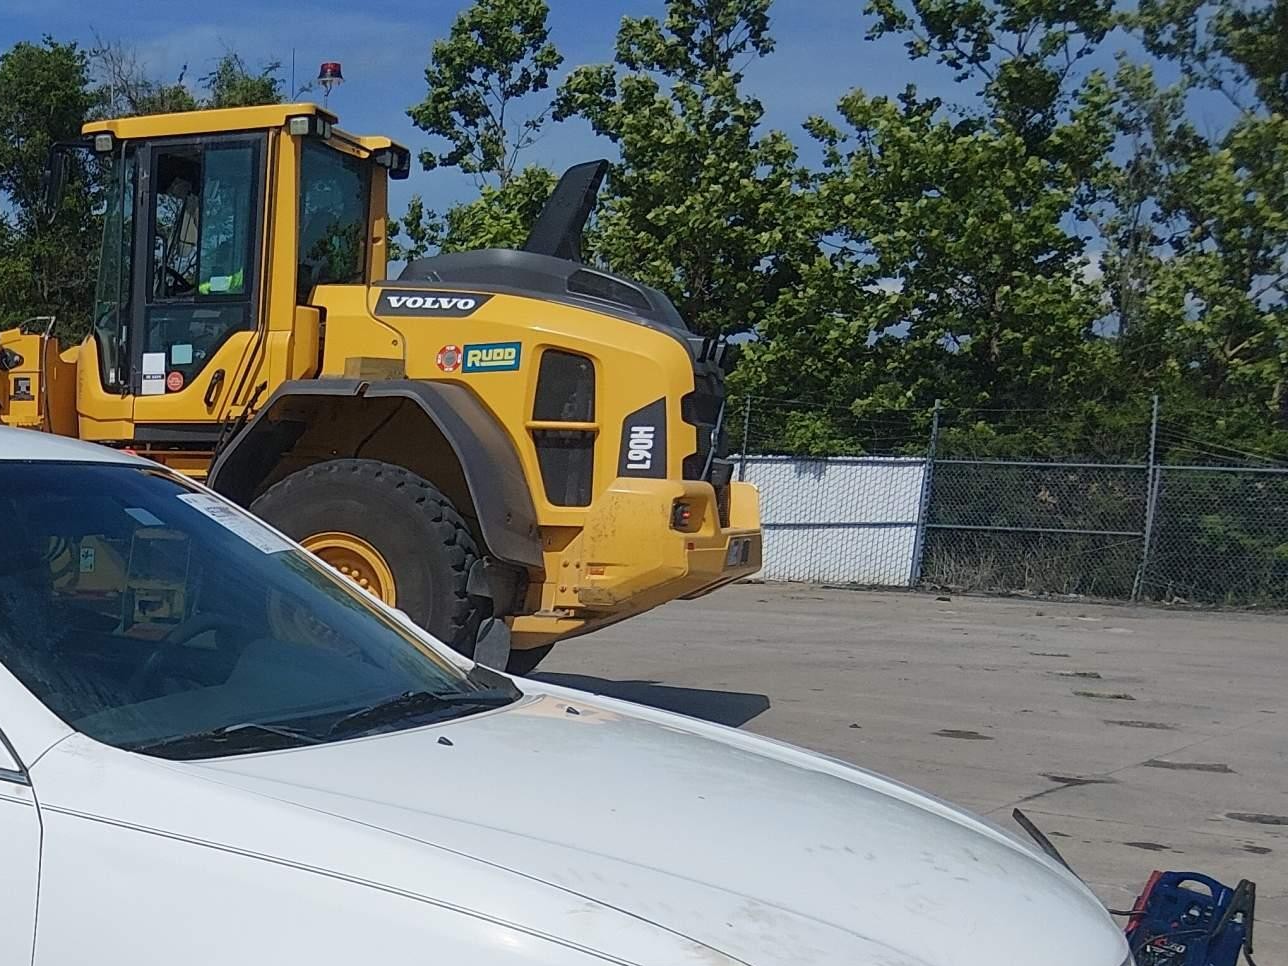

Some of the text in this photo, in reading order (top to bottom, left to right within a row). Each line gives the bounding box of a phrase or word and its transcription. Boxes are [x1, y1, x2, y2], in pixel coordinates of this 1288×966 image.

[387, 294, 476, 310] VOLVO
[467, 347, 516, 368] RUDD
[626, 426, 655, 470] L90H
